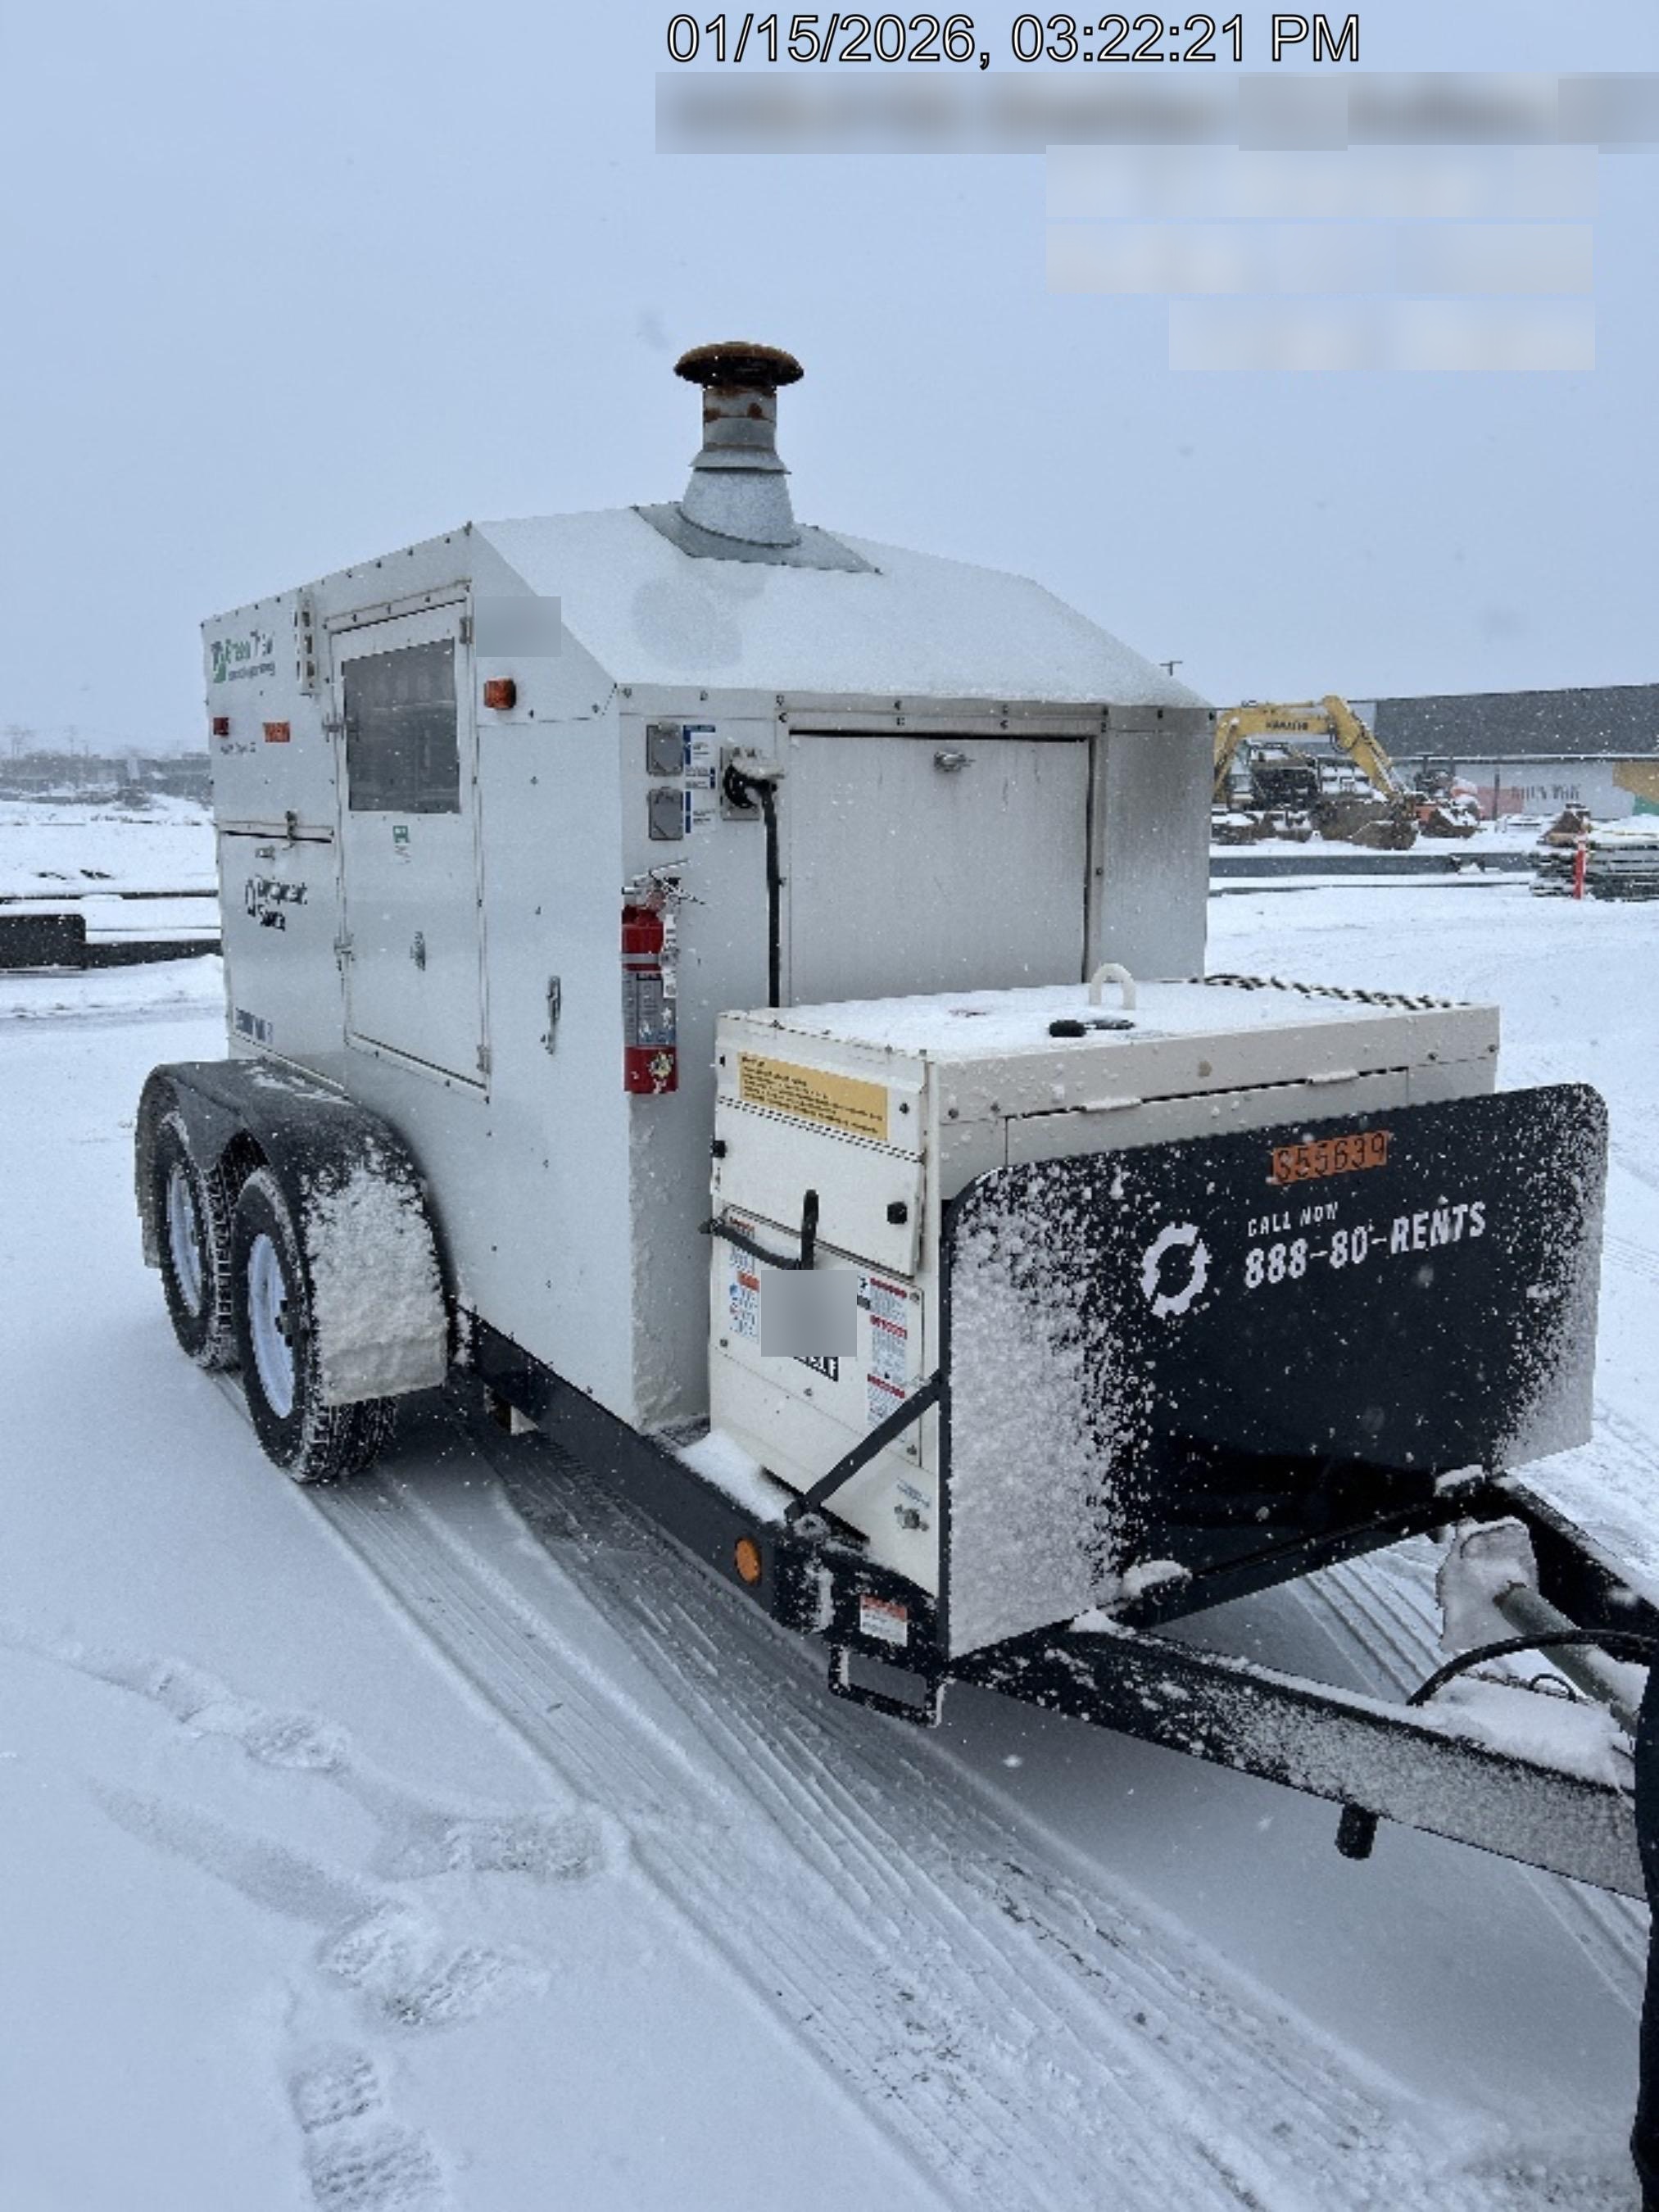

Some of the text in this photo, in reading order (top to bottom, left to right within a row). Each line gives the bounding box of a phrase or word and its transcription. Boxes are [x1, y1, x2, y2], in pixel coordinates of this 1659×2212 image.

[1244, 1200, 1487, 1290] 888-80-RENTS
[1248, 1201, 1339, 1237] CALL NOW
